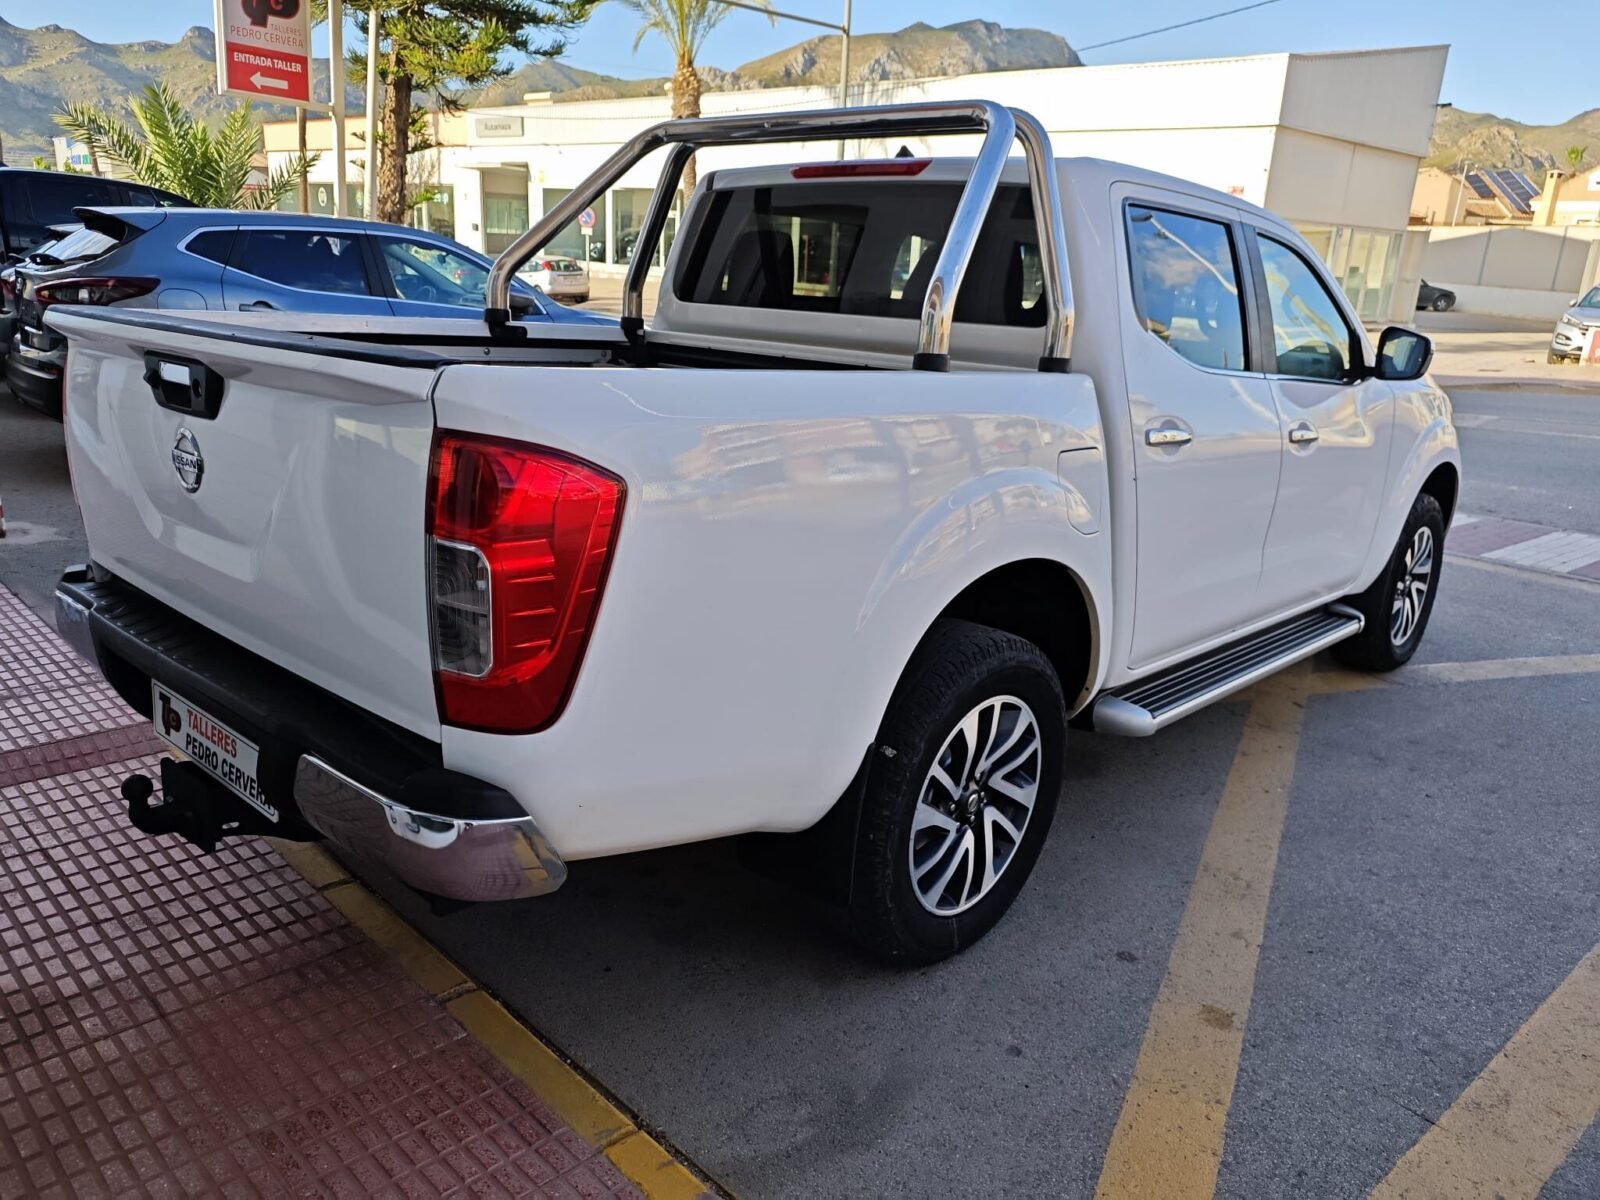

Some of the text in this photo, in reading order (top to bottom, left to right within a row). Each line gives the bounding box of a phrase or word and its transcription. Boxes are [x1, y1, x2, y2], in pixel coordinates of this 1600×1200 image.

[231, 25, 304, 48] PEDRO CERVERA
[270, 23, 302, 37] TALLERES
[234, 52, 302, 73] ENTRADA TALLER
[173, 452, 197, 470] NISSAN
[186, 709, 238, 759] TALLERES
[186, 733, 219, 772] PEDRO
